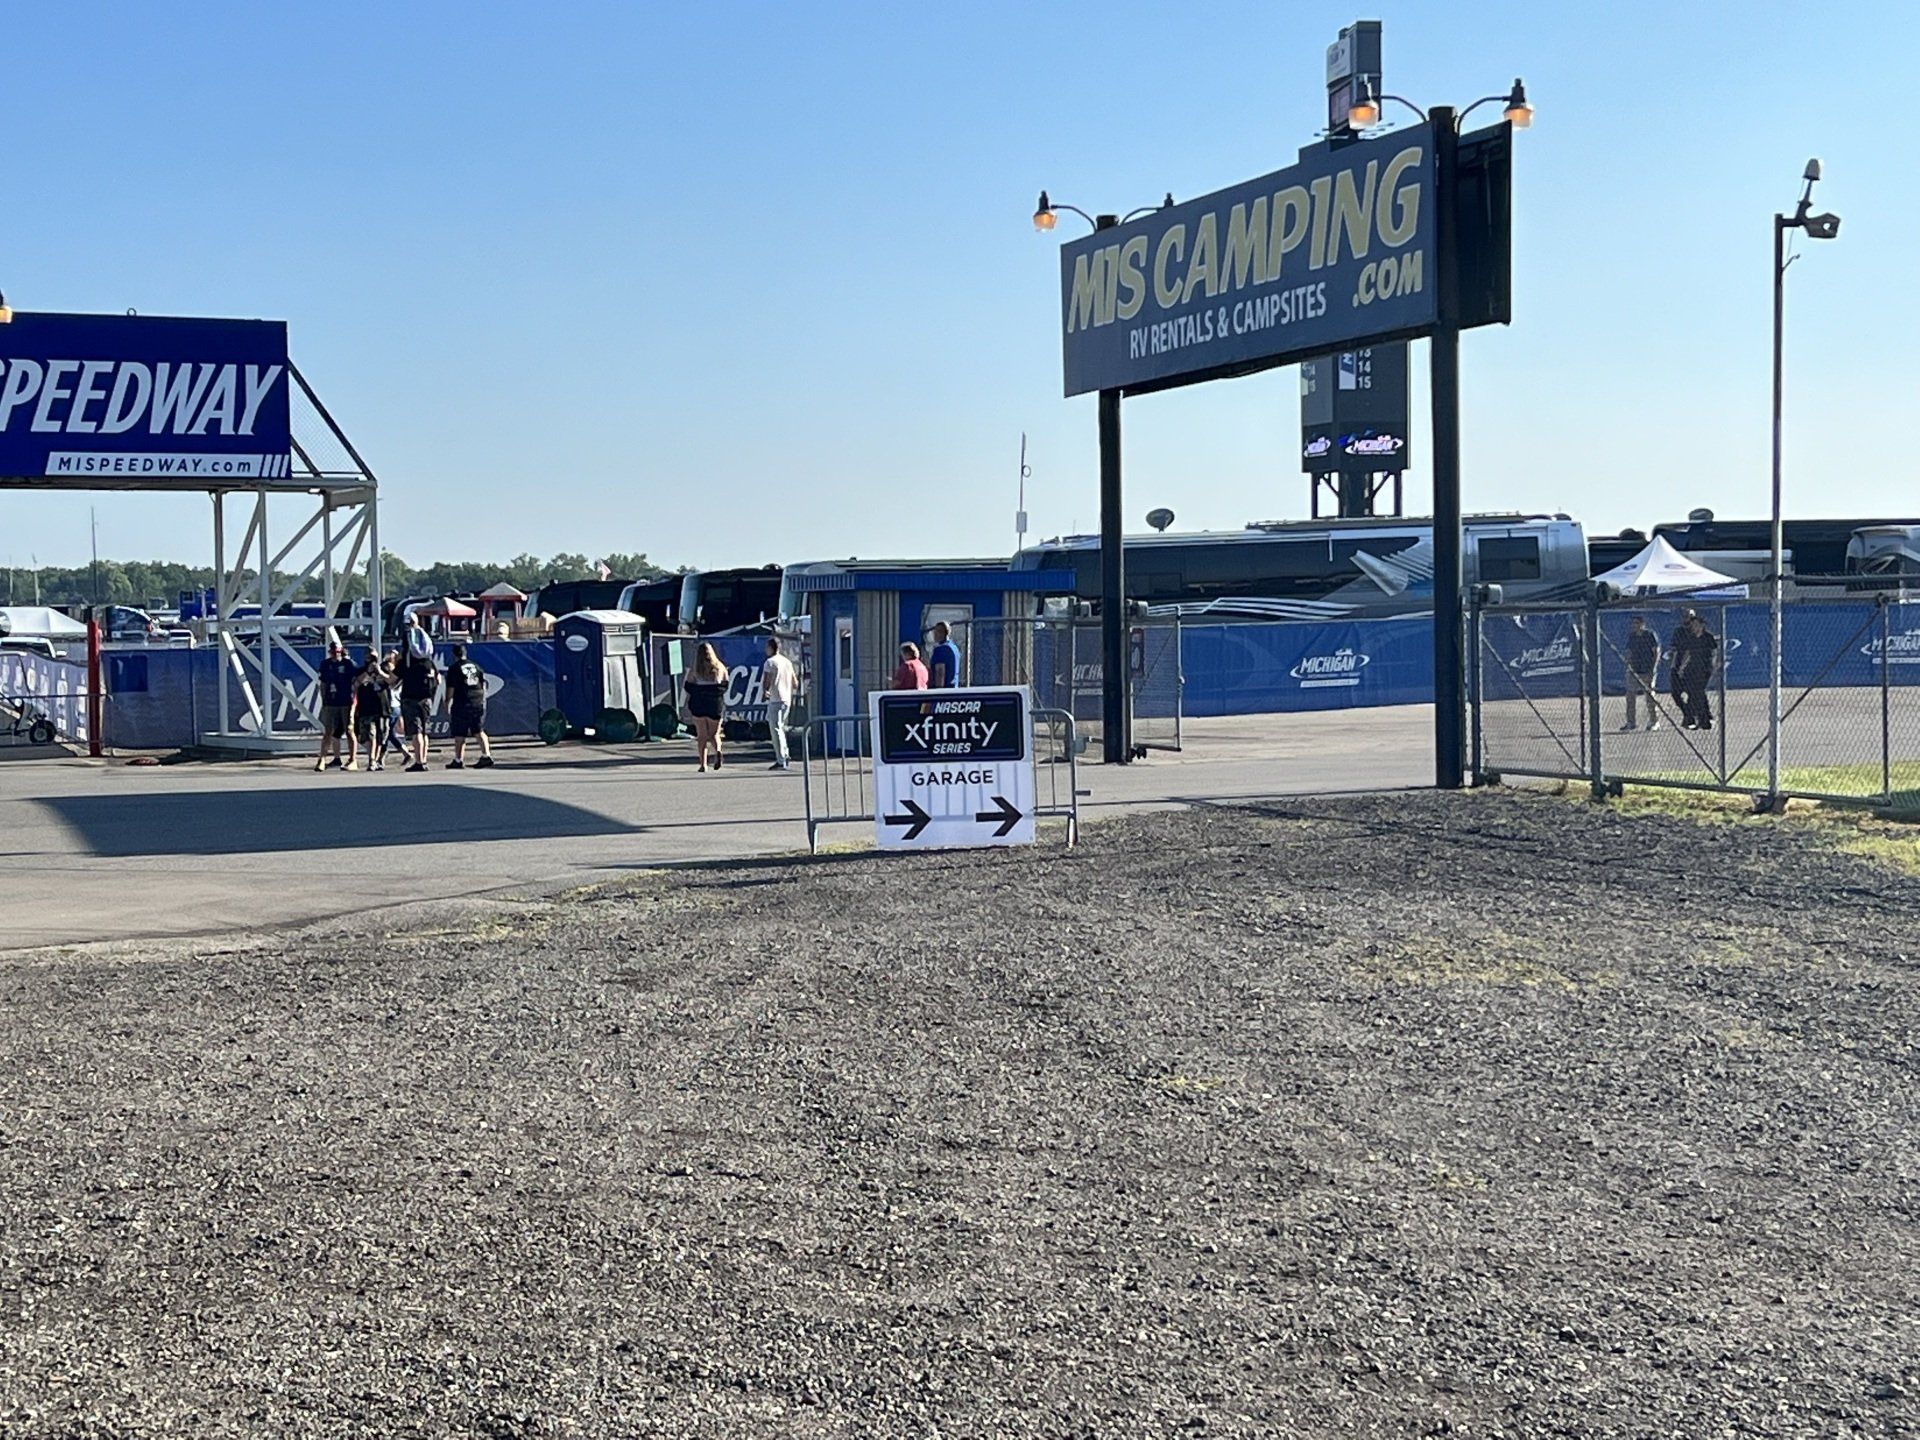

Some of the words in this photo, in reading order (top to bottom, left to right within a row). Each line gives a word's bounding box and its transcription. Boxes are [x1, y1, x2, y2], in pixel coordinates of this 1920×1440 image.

[1067, 235, 1148, 333] MIS
[1153, 146, 1422, 308] CAMPING
[1353, 251, 1422, 308] .COM
[1130, 327, 1148, 359] RV
[1151, 309, 1213, 352] RENTALS
[1217, 311, 1229, 338] &
[1233, 282, 1326, 335] CAMPSITES
[1358, 360, 1371, 373] 14
[1358, 375, 1372, 389] 15
[0, 358, 283, 436] PEEDWAY
[58, 456, 251, 473] MISPEEDWAY.com
[1300, 655, 1357, 673] MICHIGAN
[935, 701, 981, 713] NASCAR
[904, 716, 998, 748] xfinity
[932, 742, 971, 754] SERIES
[911, 770, 993, 786] GARAGE
